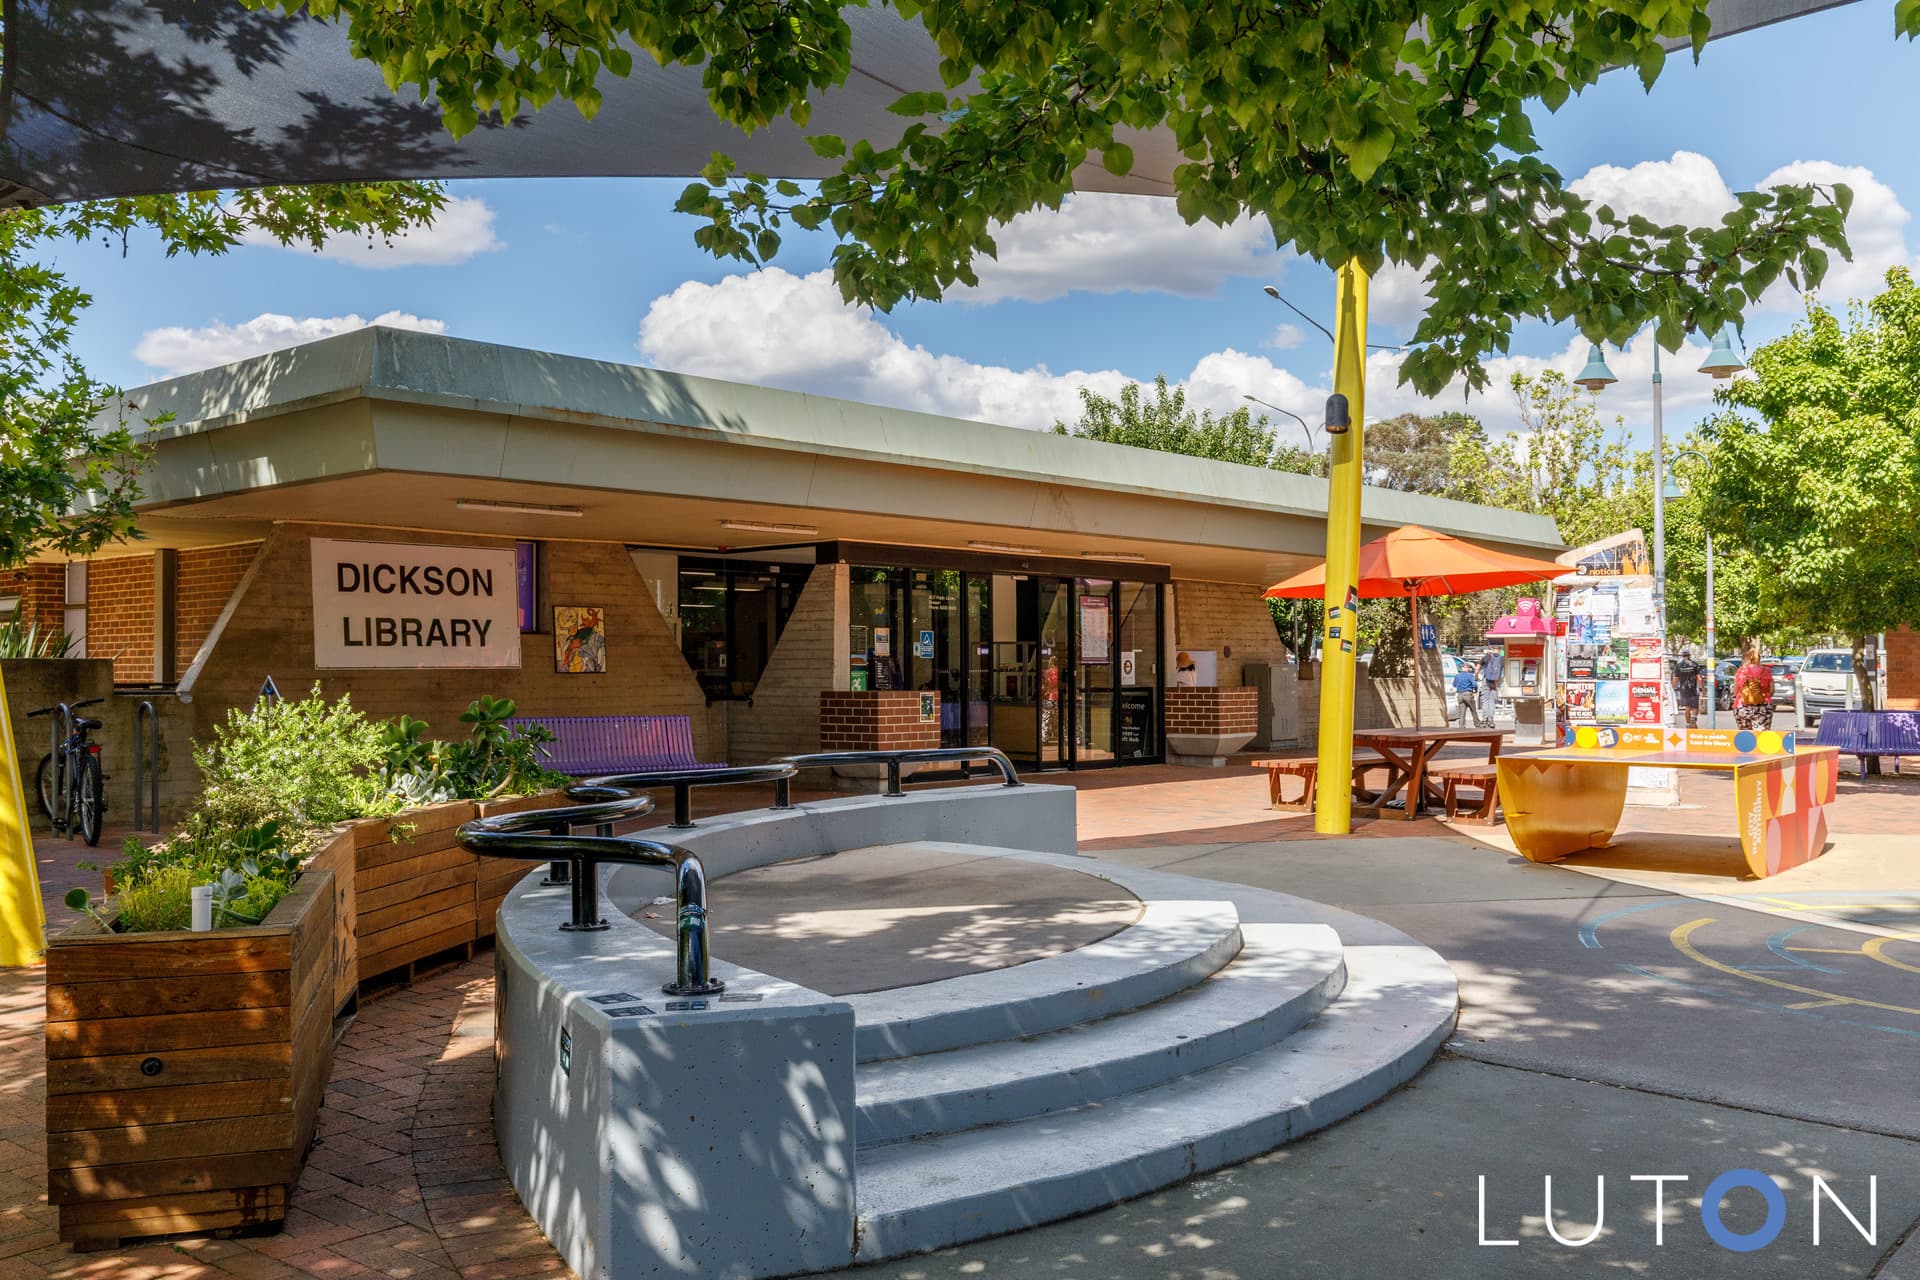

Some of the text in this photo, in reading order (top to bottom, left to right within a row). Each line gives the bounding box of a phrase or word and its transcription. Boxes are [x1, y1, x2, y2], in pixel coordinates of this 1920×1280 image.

[336, 562, 493, 597] DICKSON
[1589, 568, 1620, 576] notices
[343, 616, 492, 647] LIBRARY
